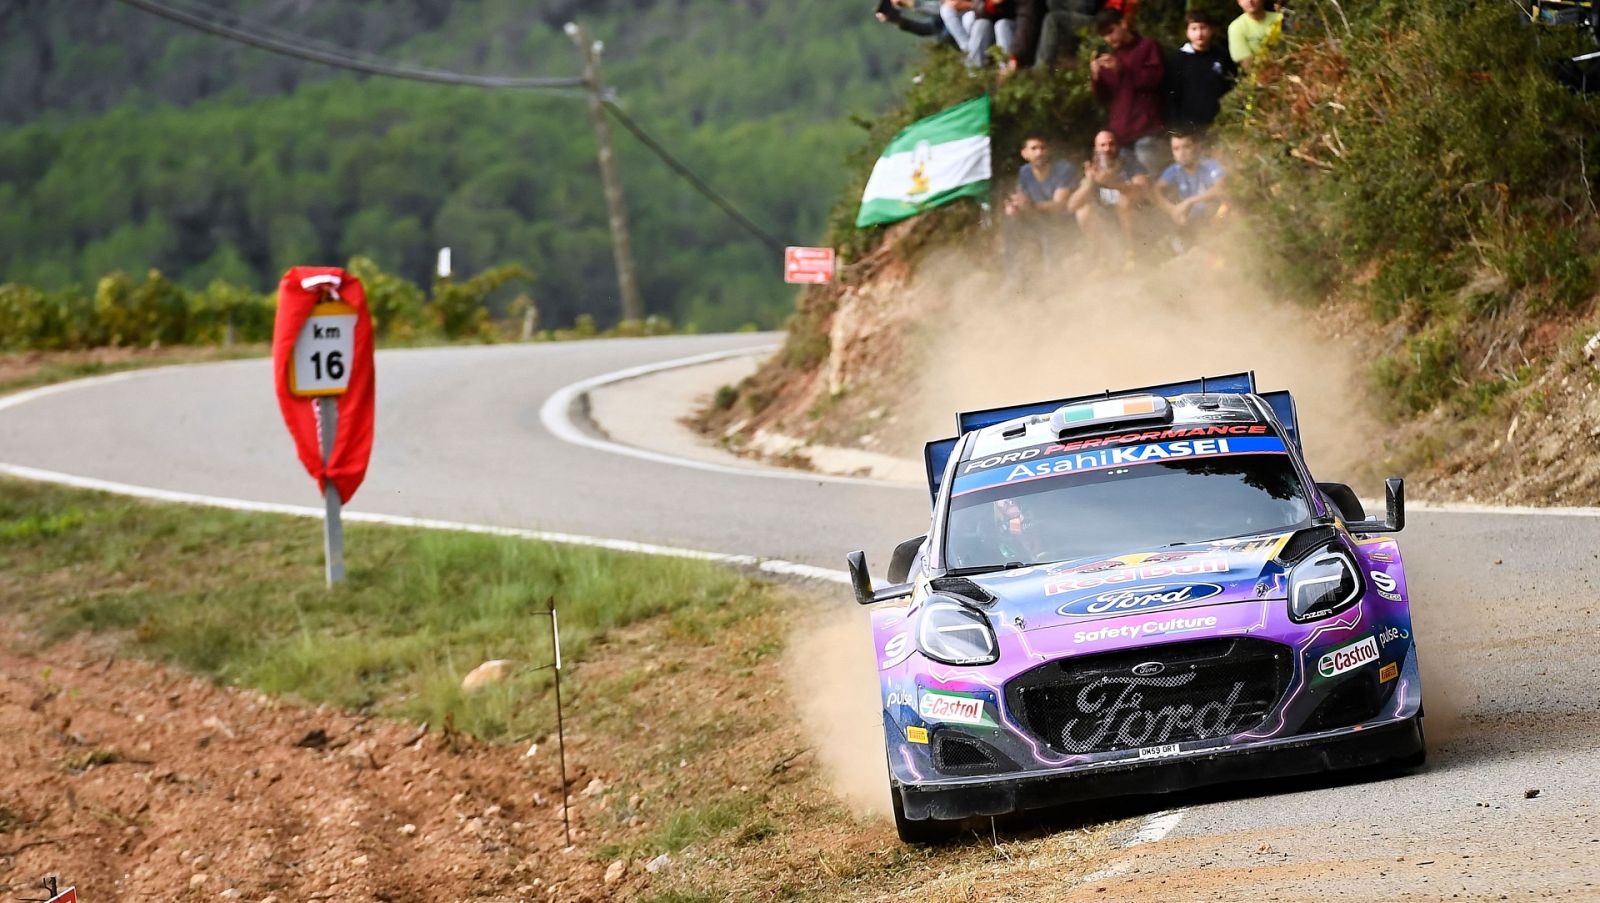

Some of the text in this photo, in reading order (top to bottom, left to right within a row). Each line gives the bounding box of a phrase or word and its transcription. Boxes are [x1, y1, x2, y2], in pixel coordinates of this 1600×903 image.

[313, 324, 341, 339] km
[310, 351, 344, 380] 16
[964, 425, 1267, 474] FORD PERFORMANCE
[1044, 558, 1230, 596] Red Bull
[1087, 585, 1192, 614] Ford
[1380, 626, 1399, 648] pulse
[1335, 639, 1377, 671] Castrol
[932, 697, 979, 719] Castrol
[1061, 672, 1245, 753] Ford
